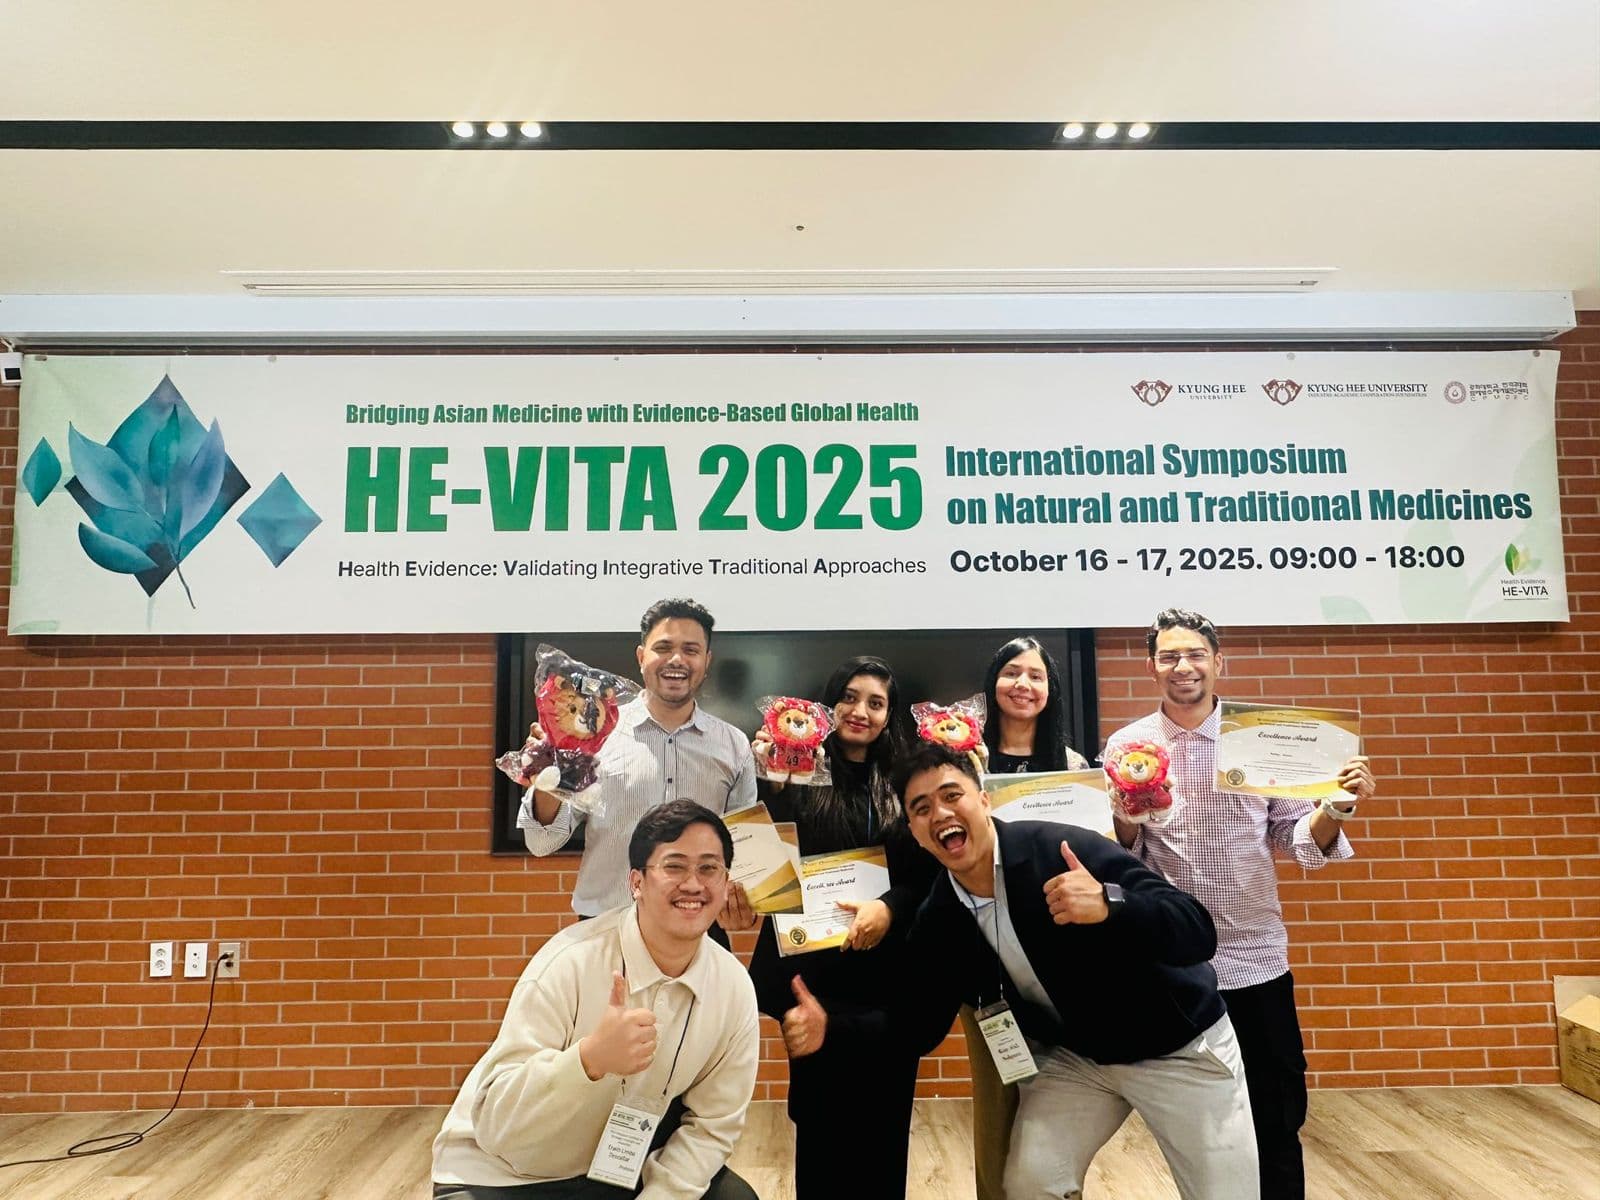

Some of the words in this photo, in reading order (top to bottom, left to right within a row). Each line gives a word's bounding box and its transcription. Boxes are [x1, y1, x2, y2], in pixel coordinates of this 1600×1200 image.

[1178, 384, 1220, 393] KYUNG
[1223, 384, 1247, 393] HEE
[1307, 384, 1344, 393] KYUNG
[1346, 384, 1366, 392] HEE
[1368, 383, 1428, 392] UNIVERSITY
[346, 404, 429, 425] Bridging
[433, 404, 488, 423] Asian
[492, 404, 582, 423] Medicine
[587, 403, 628, 422] with
[633, 403, 786, 422] Evidence-Based
[791, 403, 852, 422] Global
[857, 402, 919, 421] Health
[945, 444, 1155, 476] International
[1162, 443, 1347, 478] Symposium
[344, 446, 677, 532] HE-VITA
[698, 443, 922, 532] 2025
[947, 496, 987, 524] on
[995, 492, 1111, 524] Natural
[1119, 492, 1179, 523] and
[1185, 490, 1362, 522] Traditional
[1368, 489, 1533, 521] Medicines
[950, 549, 1068, 572] October
[1075, 549, 1108, 571] 16
[1136, 549, 1173, 577] 17,
[1179, 547, 1262, 571] 2025.
[1269, 546, 1357, 569] 09:00
[1384, 545, 1465, 568] 18:00
[338, 561, 399, 577] Health
[405, 561, 497, 577] Evidence:
[503, 560, 597, 580] Validating
[603, 559, 703, 579] Integrative
[709, 558, 808, 575] Traditional
[813, 558, 927, 578] Approaches
[1502, 586, 1548, 596] HE-VITA
[1258, 731, 1291, 741] Excellence
[786, 755, 799, 766] 49
[1022, 801, 1051, 809] Excellence
[1053, 799, 1074, 807] Award
[835, 876, 856, 887] Award
